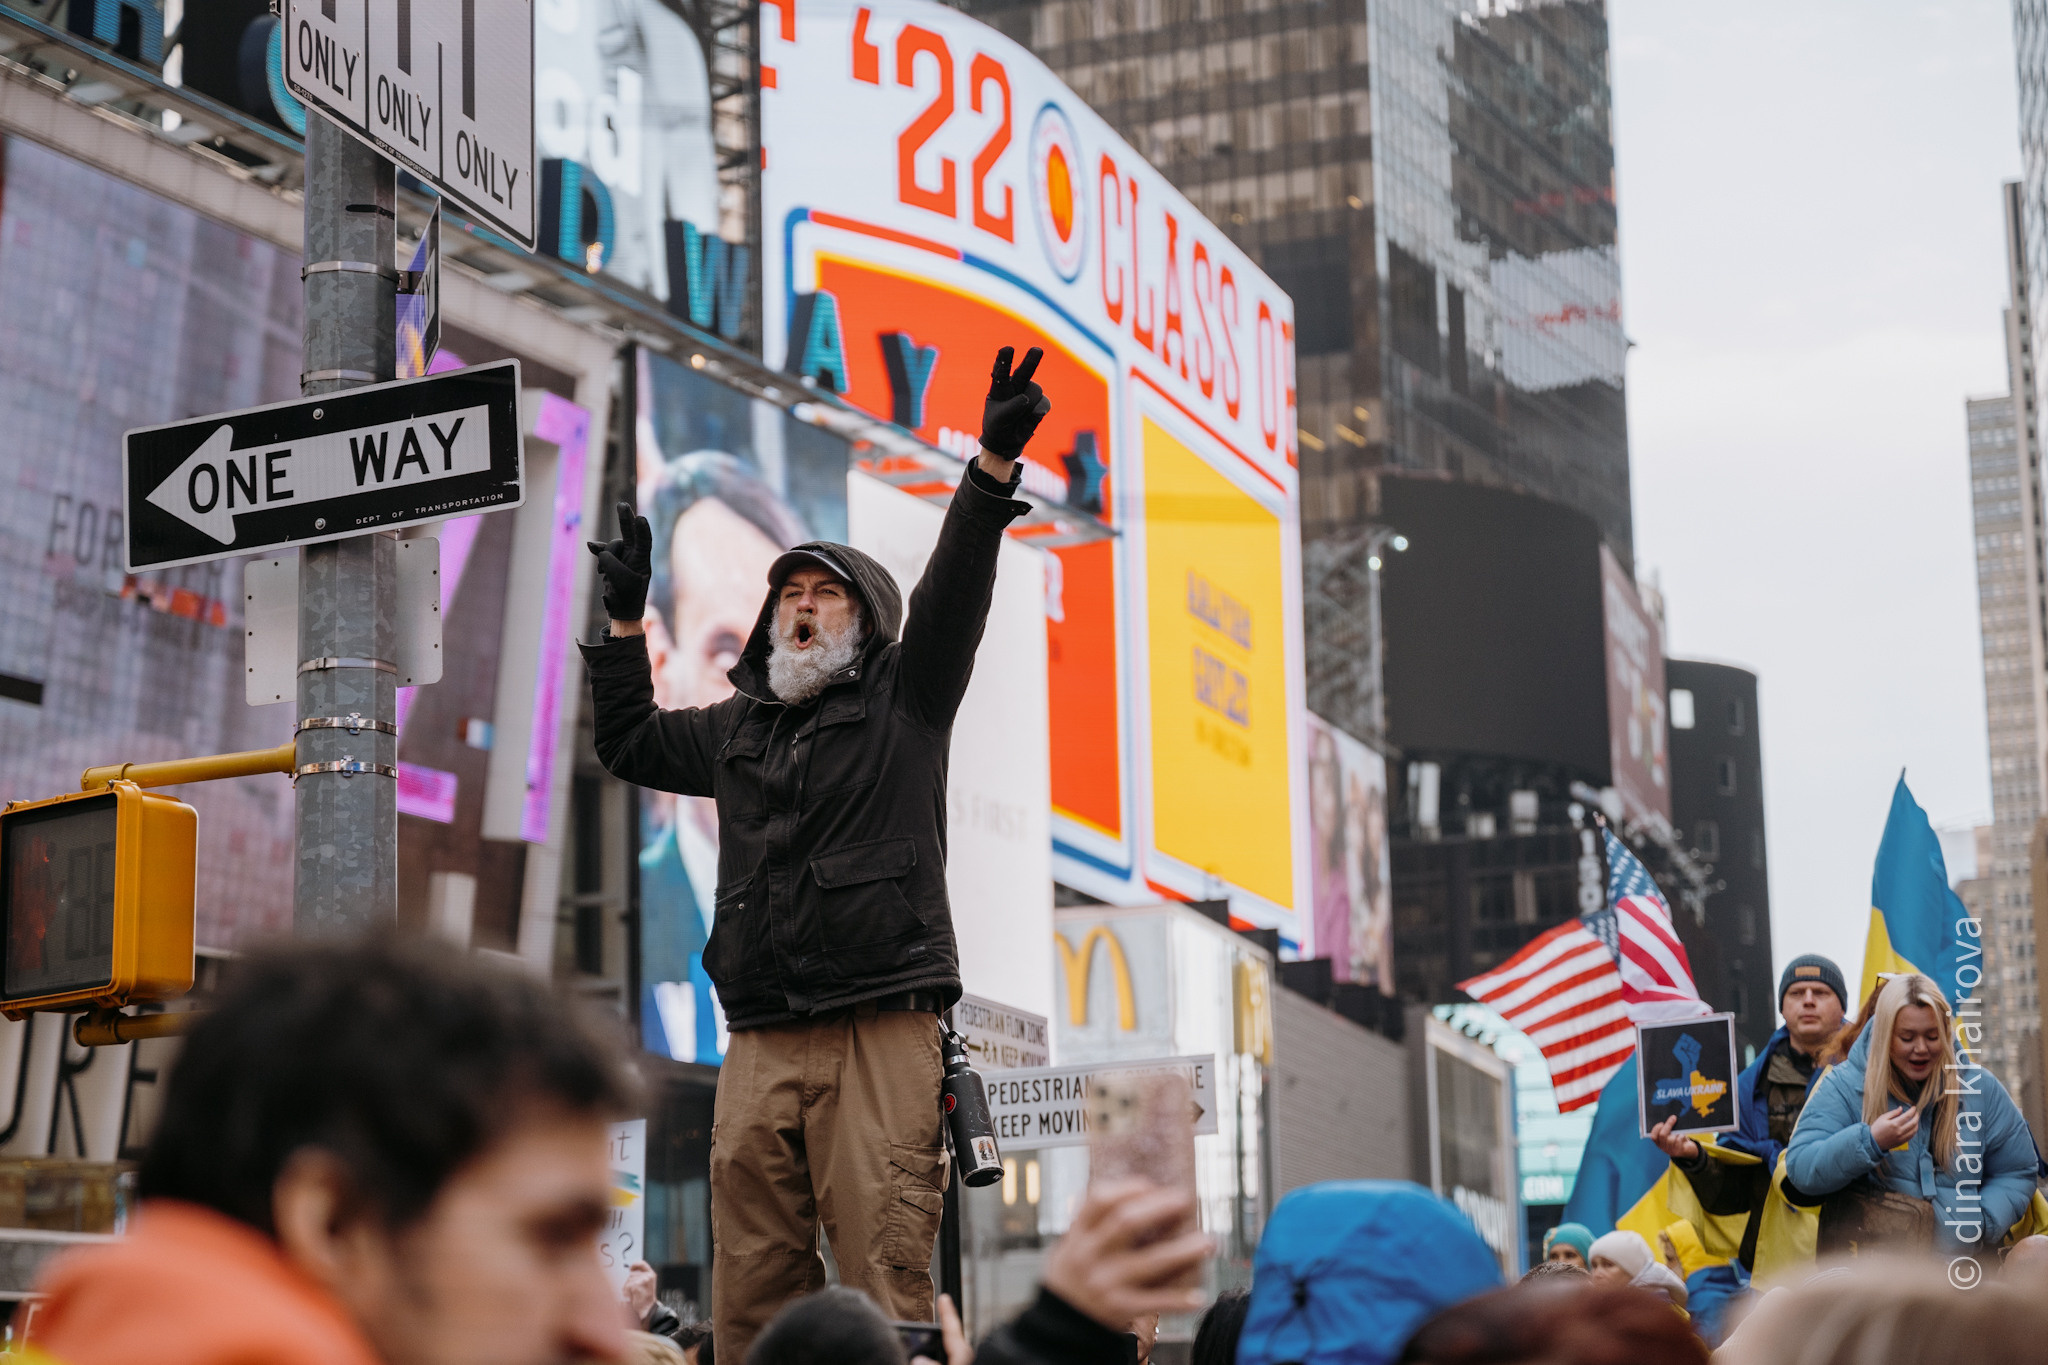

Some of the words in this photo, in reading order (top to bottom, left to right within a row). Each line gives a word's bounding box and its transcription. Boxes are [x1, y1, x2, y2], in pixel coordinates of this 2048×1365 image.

[299, 20, 357, 101] ONLY
[377, 74, 431, 151] ONLY
[395, 150, 433, 180] TRANSPORTATION
[456, 130, 518, 210] ONLY
[1100, 152, 1241, 421] CLASS
[187, 448, 294, 514] ONE
[350, 416, 466, 486] WAY
[355, 514, 381, 525] DEPT
[391, 510, 404, 519] OF
[415, 493, 504, 514] TRANSPORTATION
[960, 1001, 1004, 1034] PEDESTRIAN
[1005, 1015, 1026, 1040] FLOW
[1027, 1021, 1045, 1047] ZONE
[1001, 1044, 1018, 1068] KEEP
[1656, 1087, 1683, 1100] SLAVA
[1039, 1108, 1092, 1135] MOVIN
